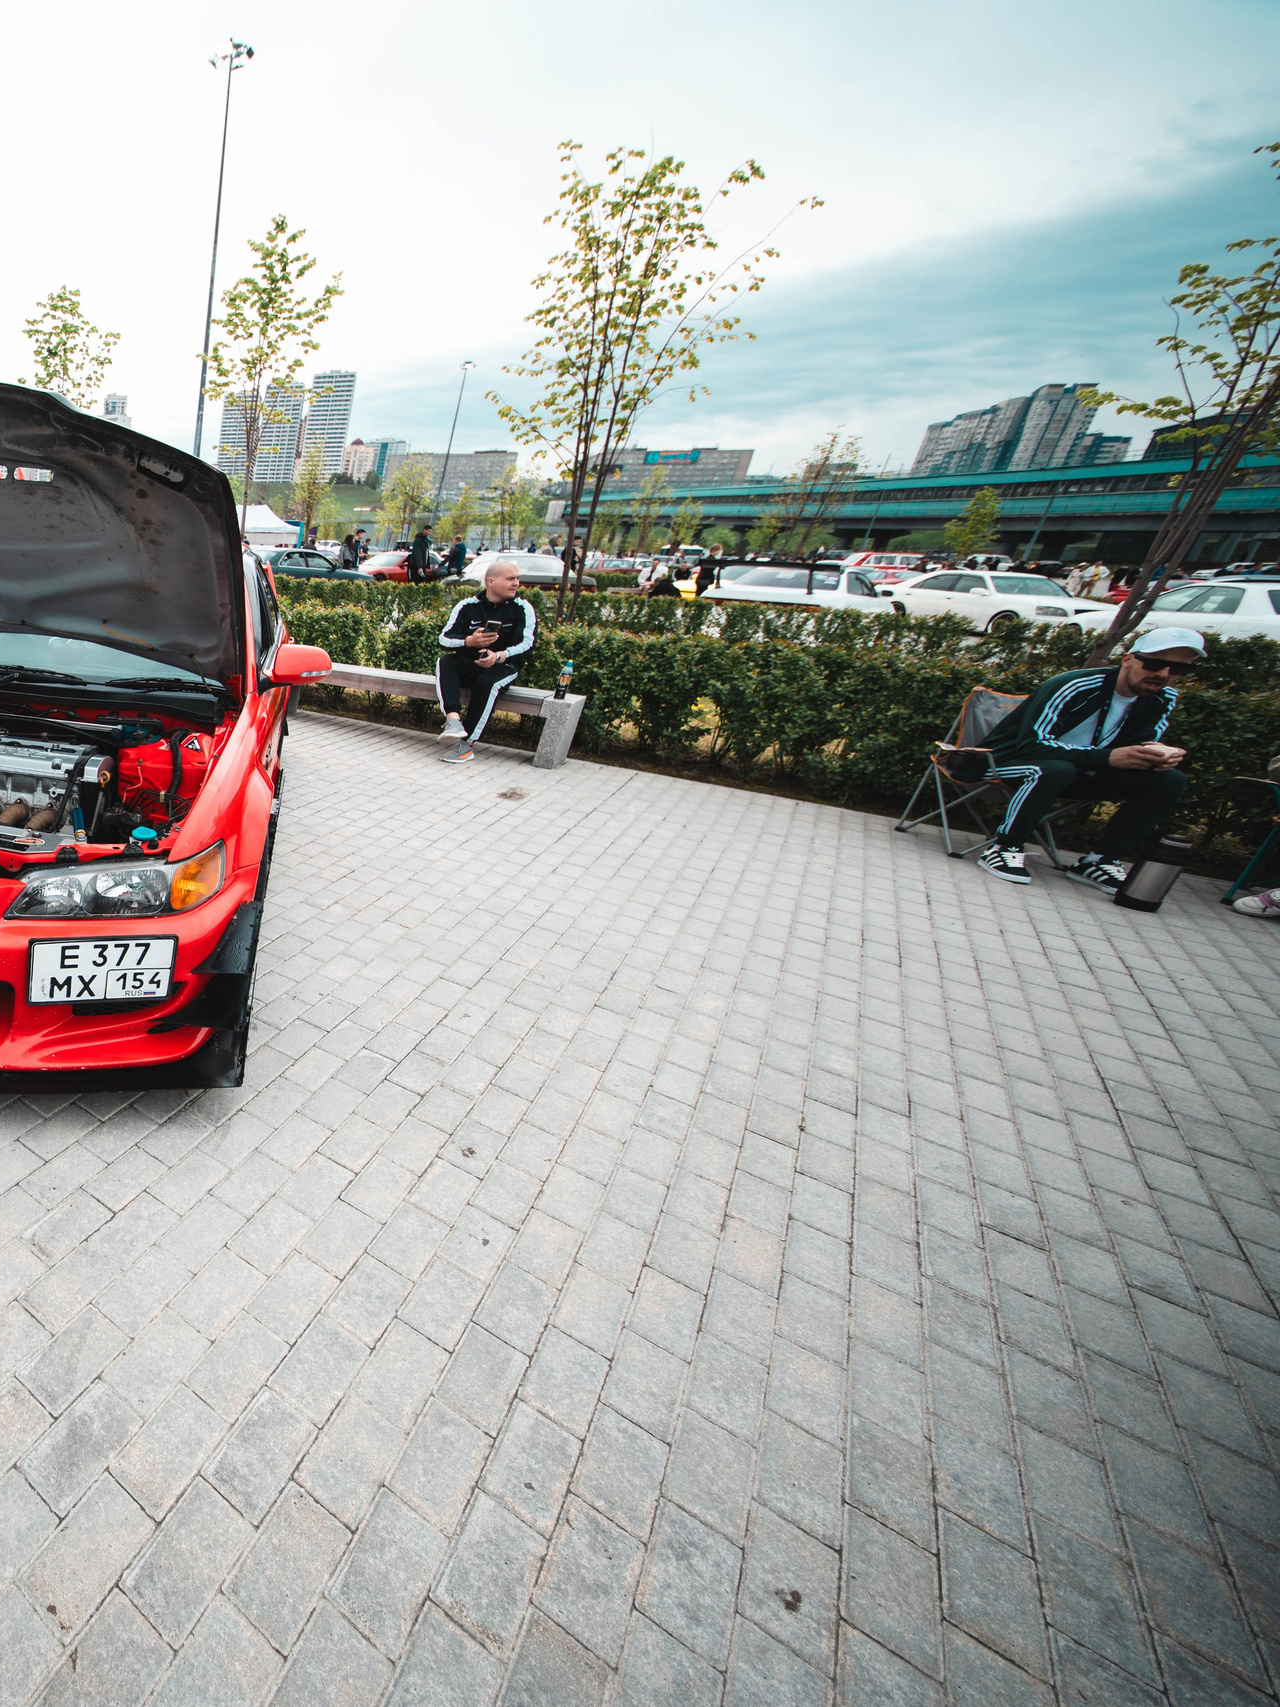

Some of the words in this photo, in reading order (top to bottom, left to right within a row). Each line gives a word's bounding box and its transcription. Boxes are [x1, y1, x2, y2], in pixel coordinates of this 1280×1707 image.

[60, 945, 80, 969] E
[92, 942, 151, 967] 377
[49, 974, 98, 999] MX
[115, 971, 161, 990] 154
[124, 989, 143, 997] RUS
